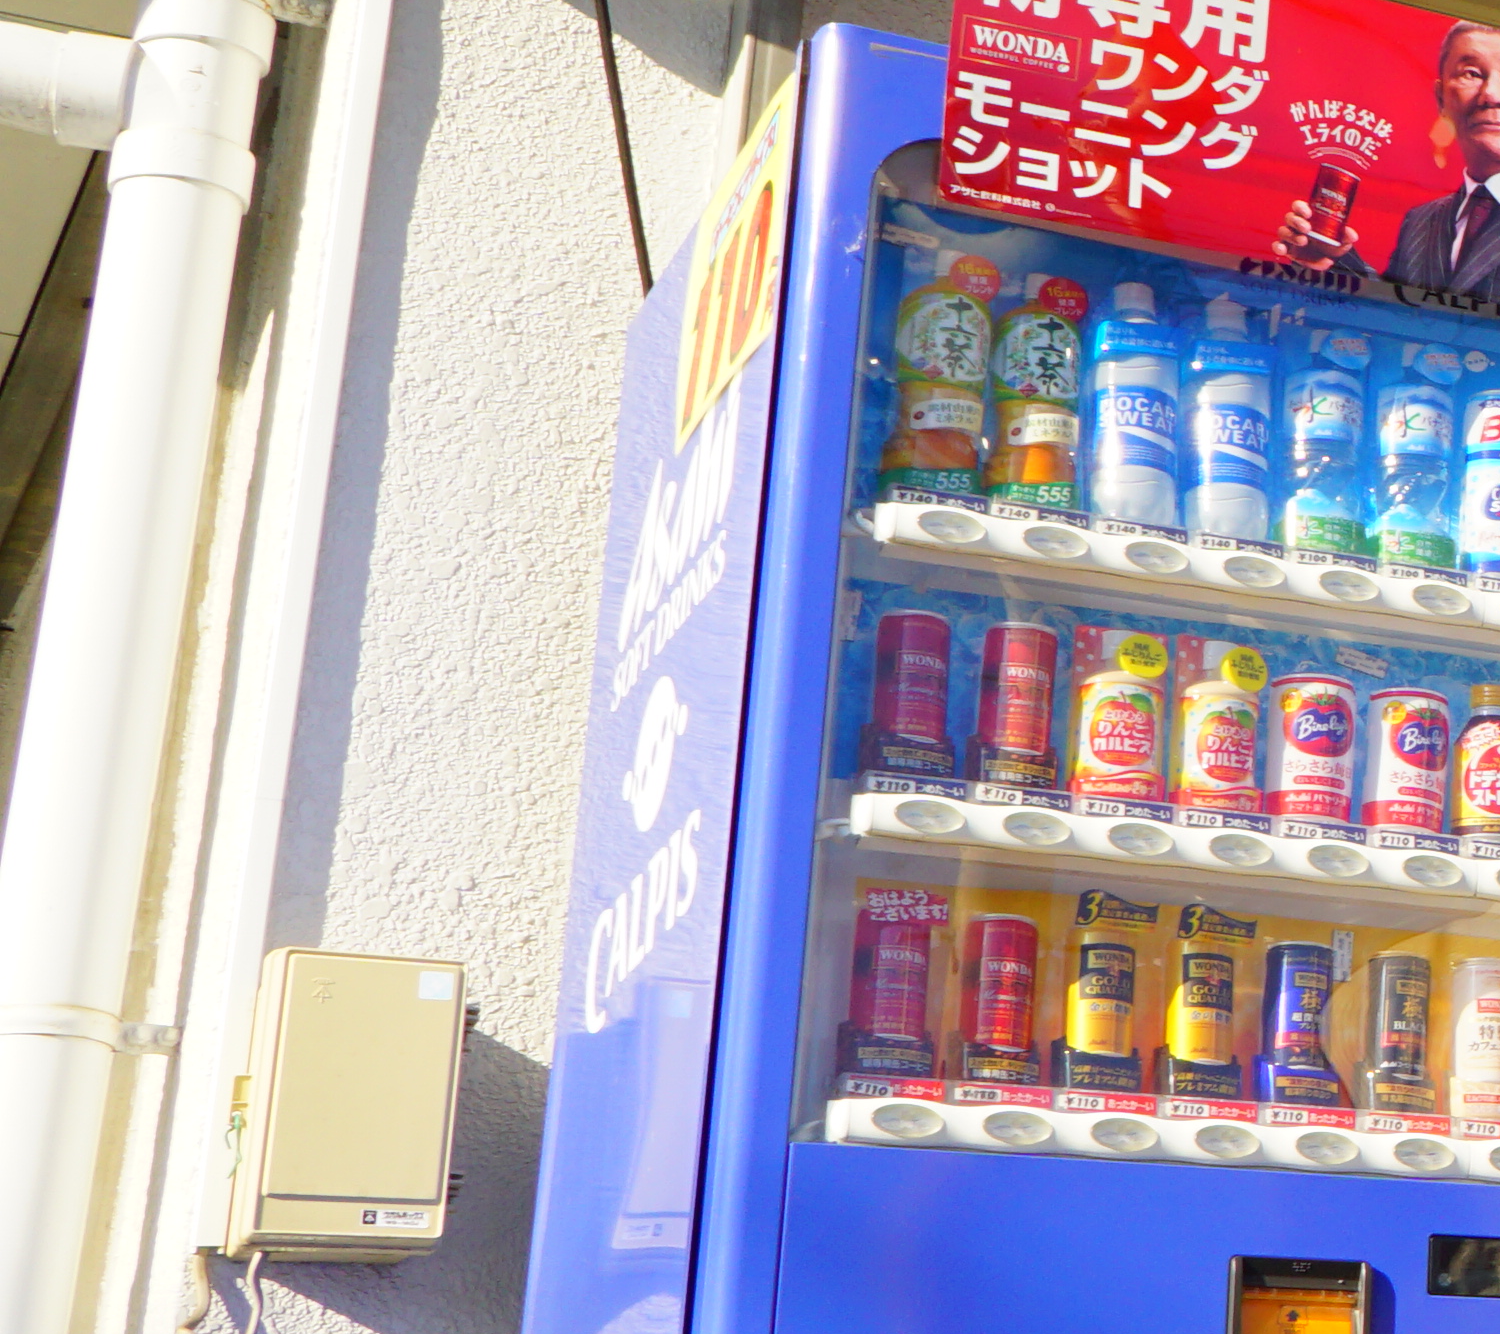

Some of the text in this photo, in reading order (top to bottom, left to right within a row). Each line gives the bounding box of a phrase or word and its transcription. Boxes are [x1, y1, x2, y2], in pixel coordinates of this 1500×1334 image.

[972, 24, 1071, 64] WONDA
[970, 46, 1054, 71] WONDERFUL COFFEE
[1091, 39, 1270, 115] ワンダ
[955, 71, 1258, 169] モーニング
[1290, 99, 1393, 145] がんばる父は、
[1300, 124, 1381, 161] エライのだ。
[952, 126, 1172, 209] ショット
[950, 183, 1041, 211] アサヒ飲料株式会社
[939, 296, 980, 379] 十六茶
[1032, 316, 1077, 395] 十六茶
[935, 471, 971, 490] 555
[896, 491, 933, 505] ¥140
[1036, 485, 1072, 504] 555
[997, 504, 1031, 519] ¥140
[1106, 523, 1137, 535] ¥140
[1202, 537, 1232, 549] ¥140
[655, 529, 727, 656] DRINKS
[1098, 722, 1151, 738] りんご
[1093, 737, 1150, 754] カルピス
[1202, 752, 1254, 771] カルピス
[874, 779, 910, 792] ¥110
[982, 786, 1017, 802] ¥110
[1088, 802, 1119, 814] ¥110
[1187, 812, 1217, 825] ¥110
[1287, 824, 1318, 837] ¥110
[1380, 835, 1410, 846] ¥110
[868, 890, 928, 906] おはよう
[585, 809, 701, 1034] CALPIS
[851, 1081, 889, 1096] ¥110
[1066, 1096, 1100, 1108] ¥110
[1173, 1105, 1205, 1115] ¥110
[1272, 1111, 1303, 1122] ¥110
[1373, 1117, 1403, 1130] ¥110
[1466, 1123, 1496, 1135] ¥110
